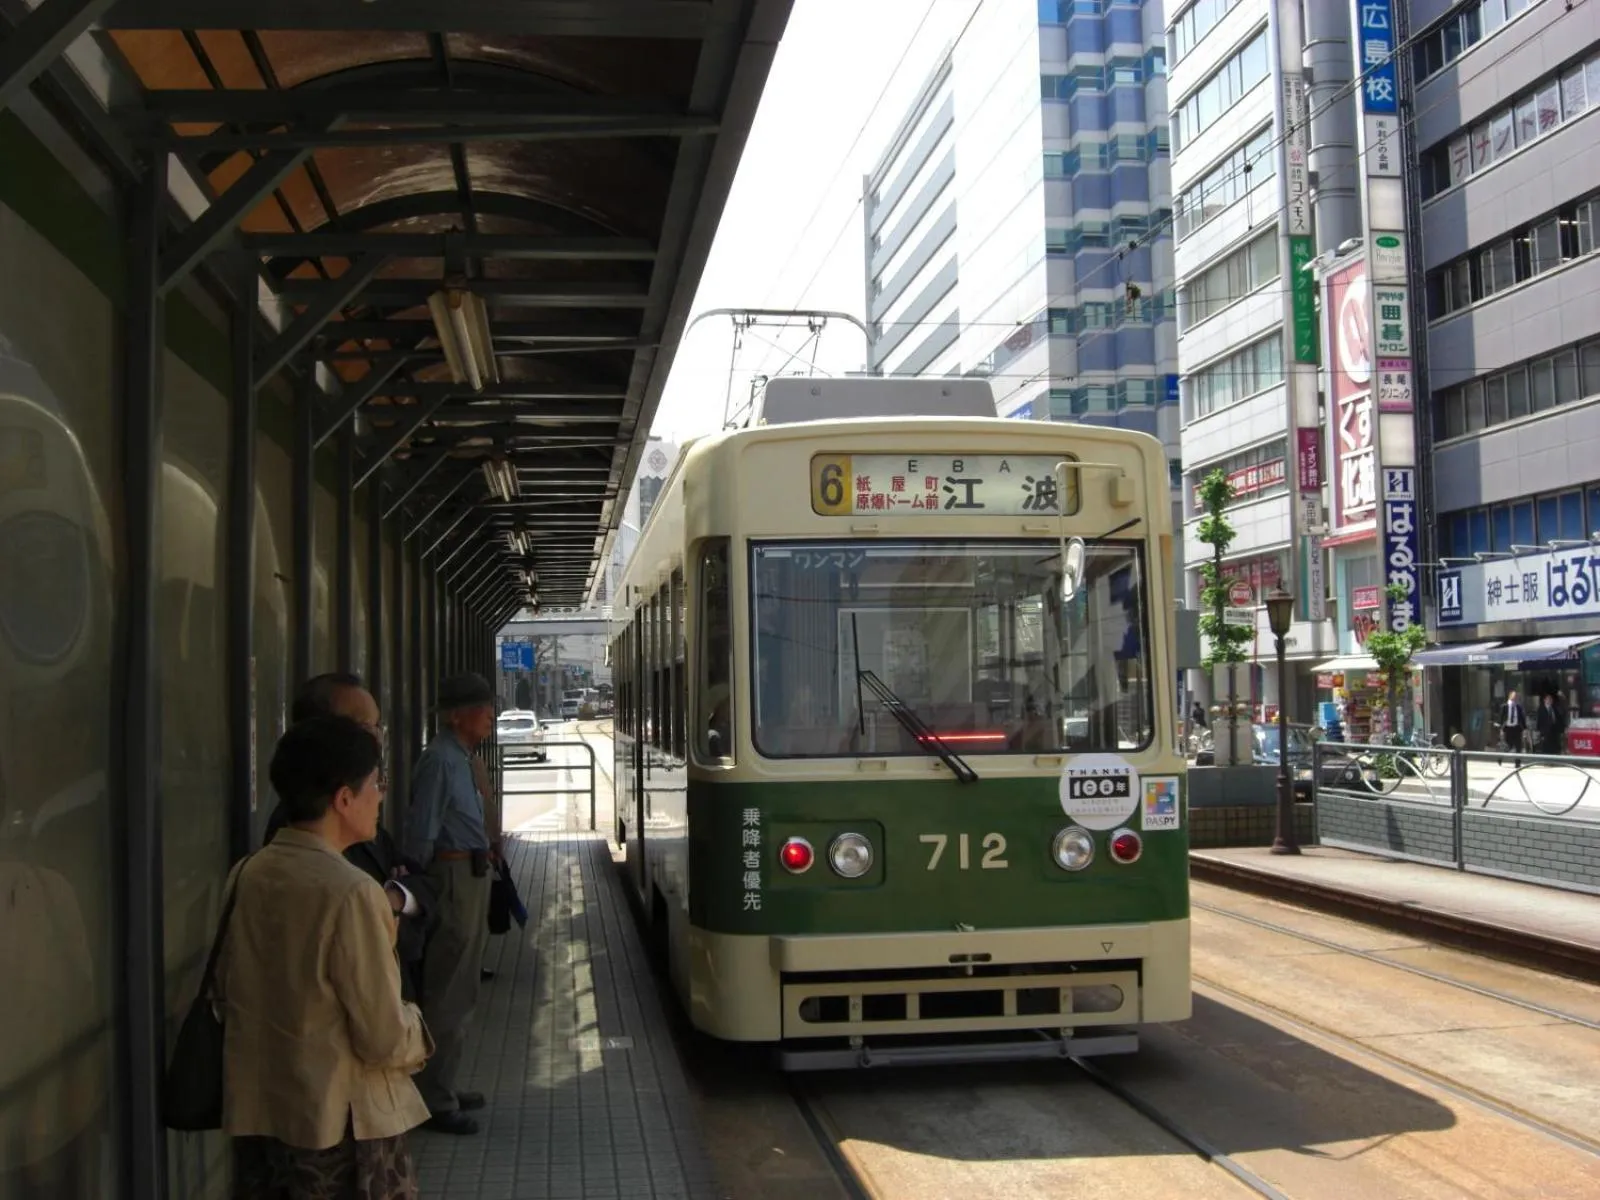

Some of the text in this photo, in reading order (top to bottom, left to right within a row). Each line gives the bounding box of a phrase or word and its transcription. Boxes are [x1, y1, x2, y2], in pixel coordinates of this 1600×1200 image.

[1362, 3, 1393, 102] 広島校
[1292, 181, 1305, 229] コスモス
[1379, 343, 1407, 352] サロン
[1380, 387, 1410, 399] クリニック
[821, 463, 844, 507] 6
[856, 475, 939, 492] 紙屋町
[943, 475, 1058, 510] 江波
[856, 493, 940, 510] 原爆ドーム前
[795, 552, 864, 569] ワンマン
[1487, 572, 1539, 606] 紳士服
[1145, 816, 1175, 826] PASPY
[742, 807, 761, 911] 乗降者優先
[919, 832, 1008, 871] 712
